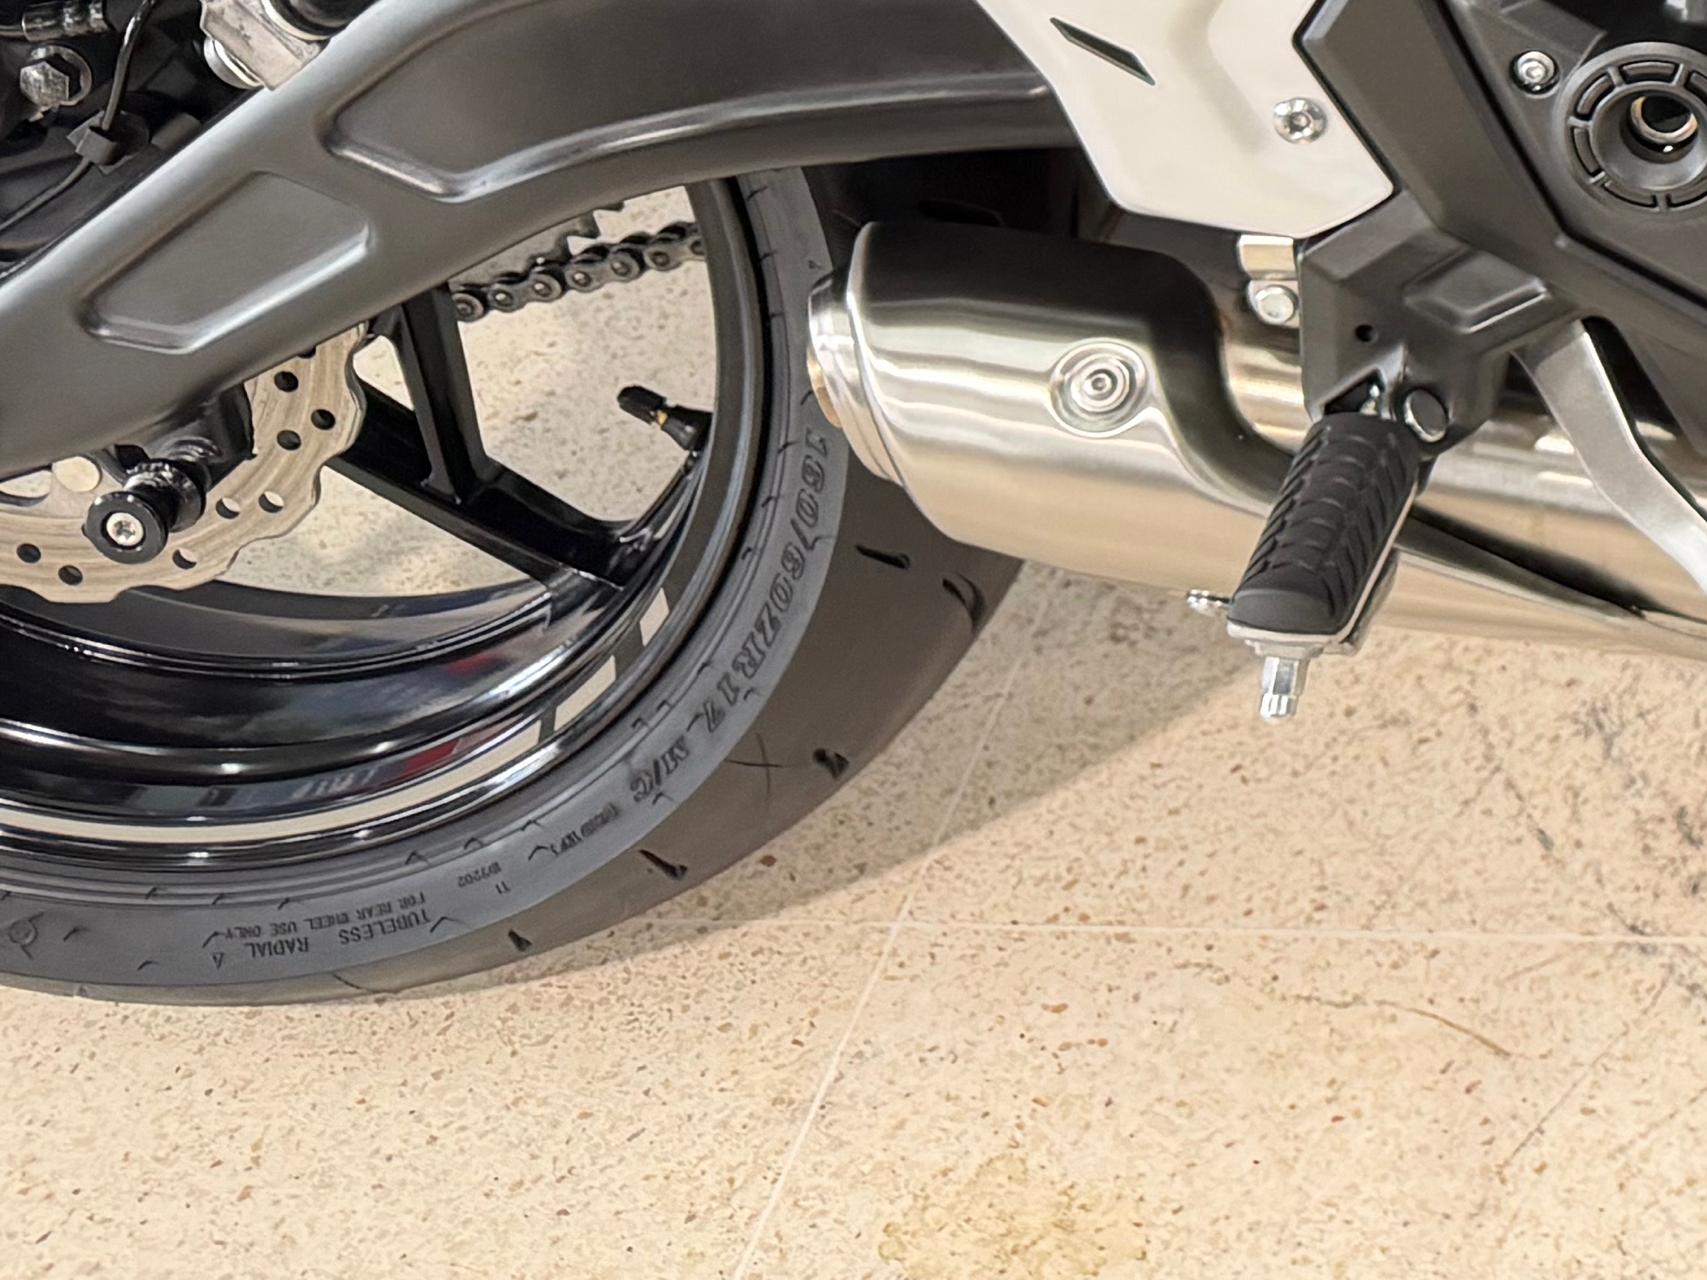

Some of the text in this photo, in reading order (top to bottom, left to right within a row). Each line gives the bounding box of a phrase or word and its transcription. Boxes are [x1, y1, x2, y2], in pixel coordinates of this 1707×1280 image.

[244, 908, 431, 958] TUBELESS RADIAL
[270, 921, 298, 934] USE
